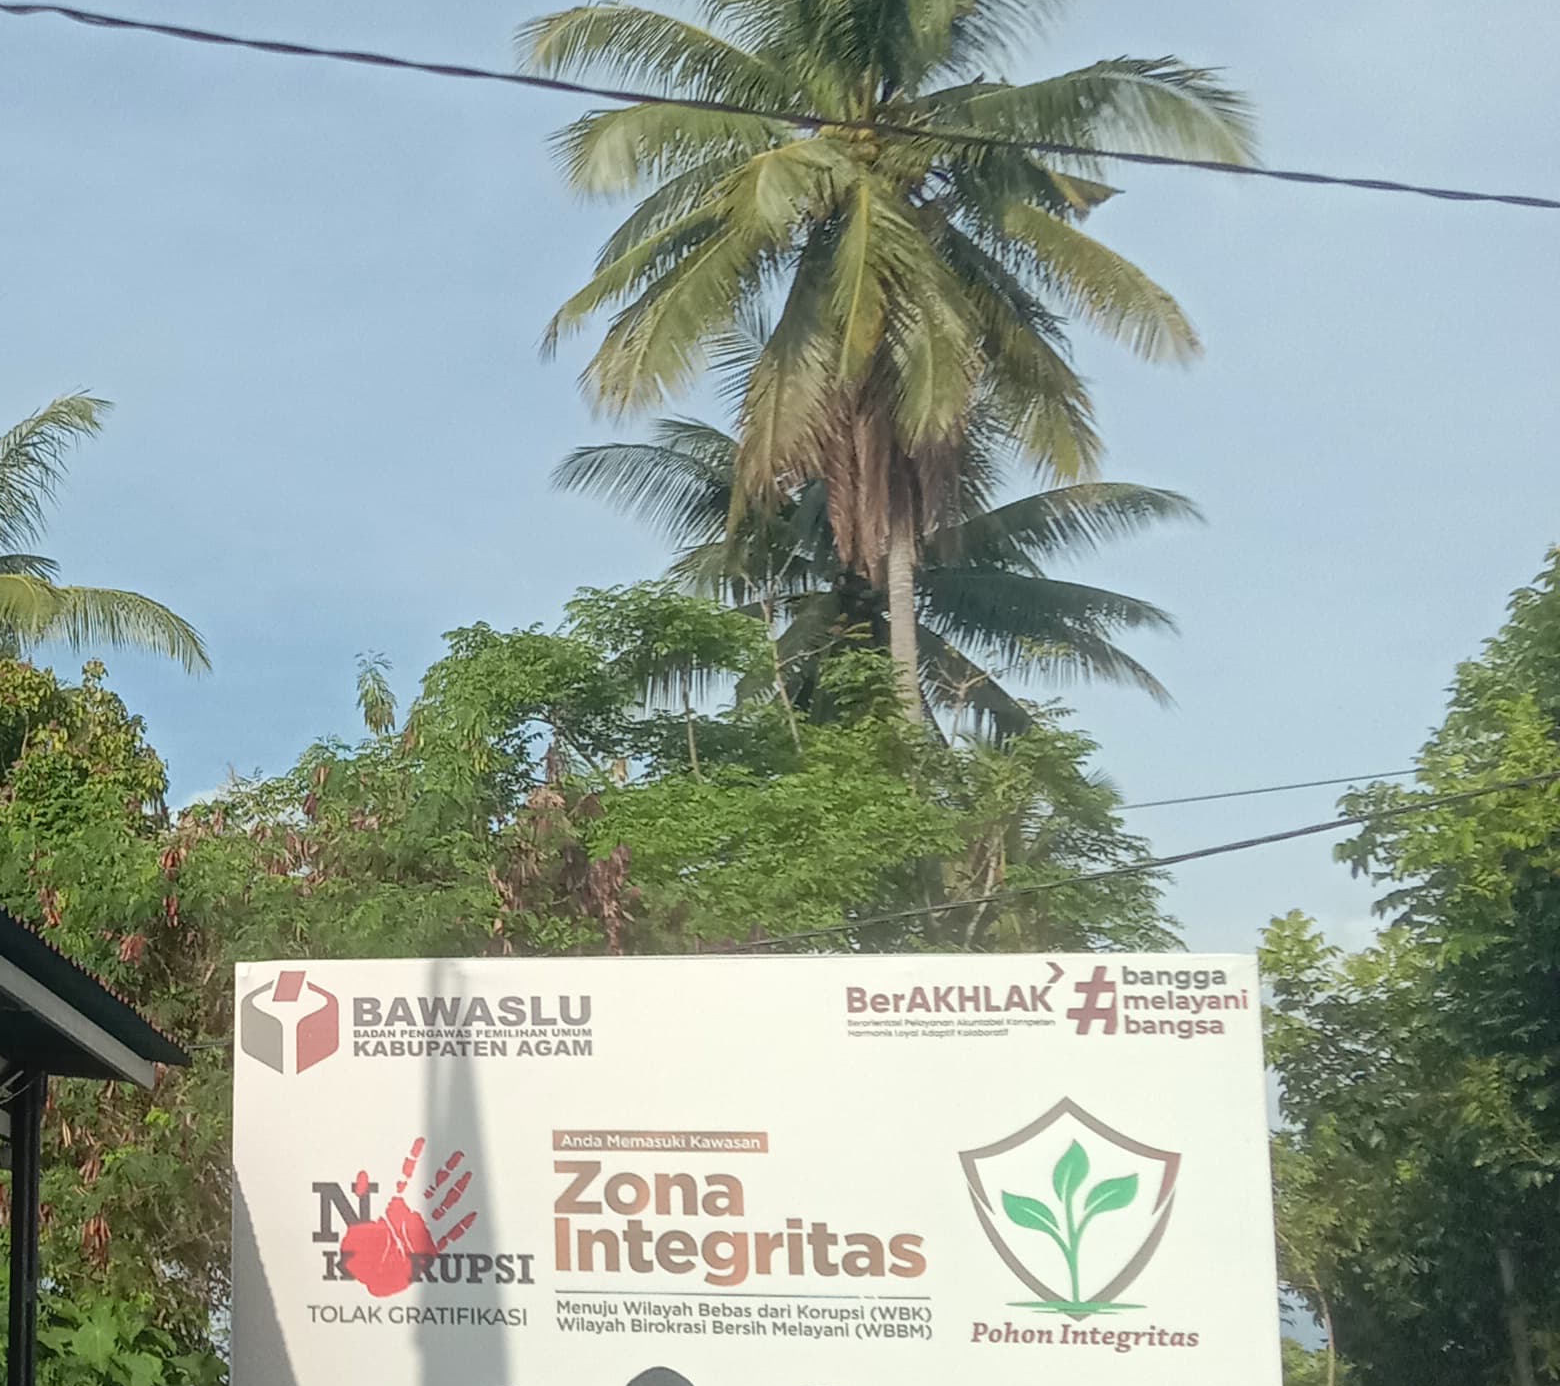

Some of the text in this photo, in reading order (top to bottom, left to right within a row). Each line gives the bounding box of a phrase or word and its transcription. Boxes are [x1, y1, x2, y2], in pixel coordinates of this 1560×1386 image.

[1121, 966, 1228, 990] bangga
[352, 995, 592, 1027] BAWASLU
[846, 985, 1054, 1014] BerAKHLAK
[1123, 989, 1249, 1014] melayani
[353, 1029, 592, 1039] BADAN PENGAWAS PEMILIHAN UMUM
[1124, 1015, 1225, 1039] bangsa
[353, 1039, 593, 1058] KABUPATEN AGAM
[560, 1134, 761, 1149] Anda Memasuki Kawasan
[554, 1160, 745, 1217] Zona
[554, 1217, 928, 1286] Integritas
[322, 1250, 536, 1284] KRUPSI
[306, 1304, 528, 1326] TOLAK GRATIFIKASI
[556, 1300, 932, 1323] Menuju Wilayah Bebas dari Korupsi (WBK)
[556, 1317, 933, 1340] Wilayah Birokrasi Bersih Melayani (WBBM)
[970, 1322, 1200, 1353] Pohon Integritas
